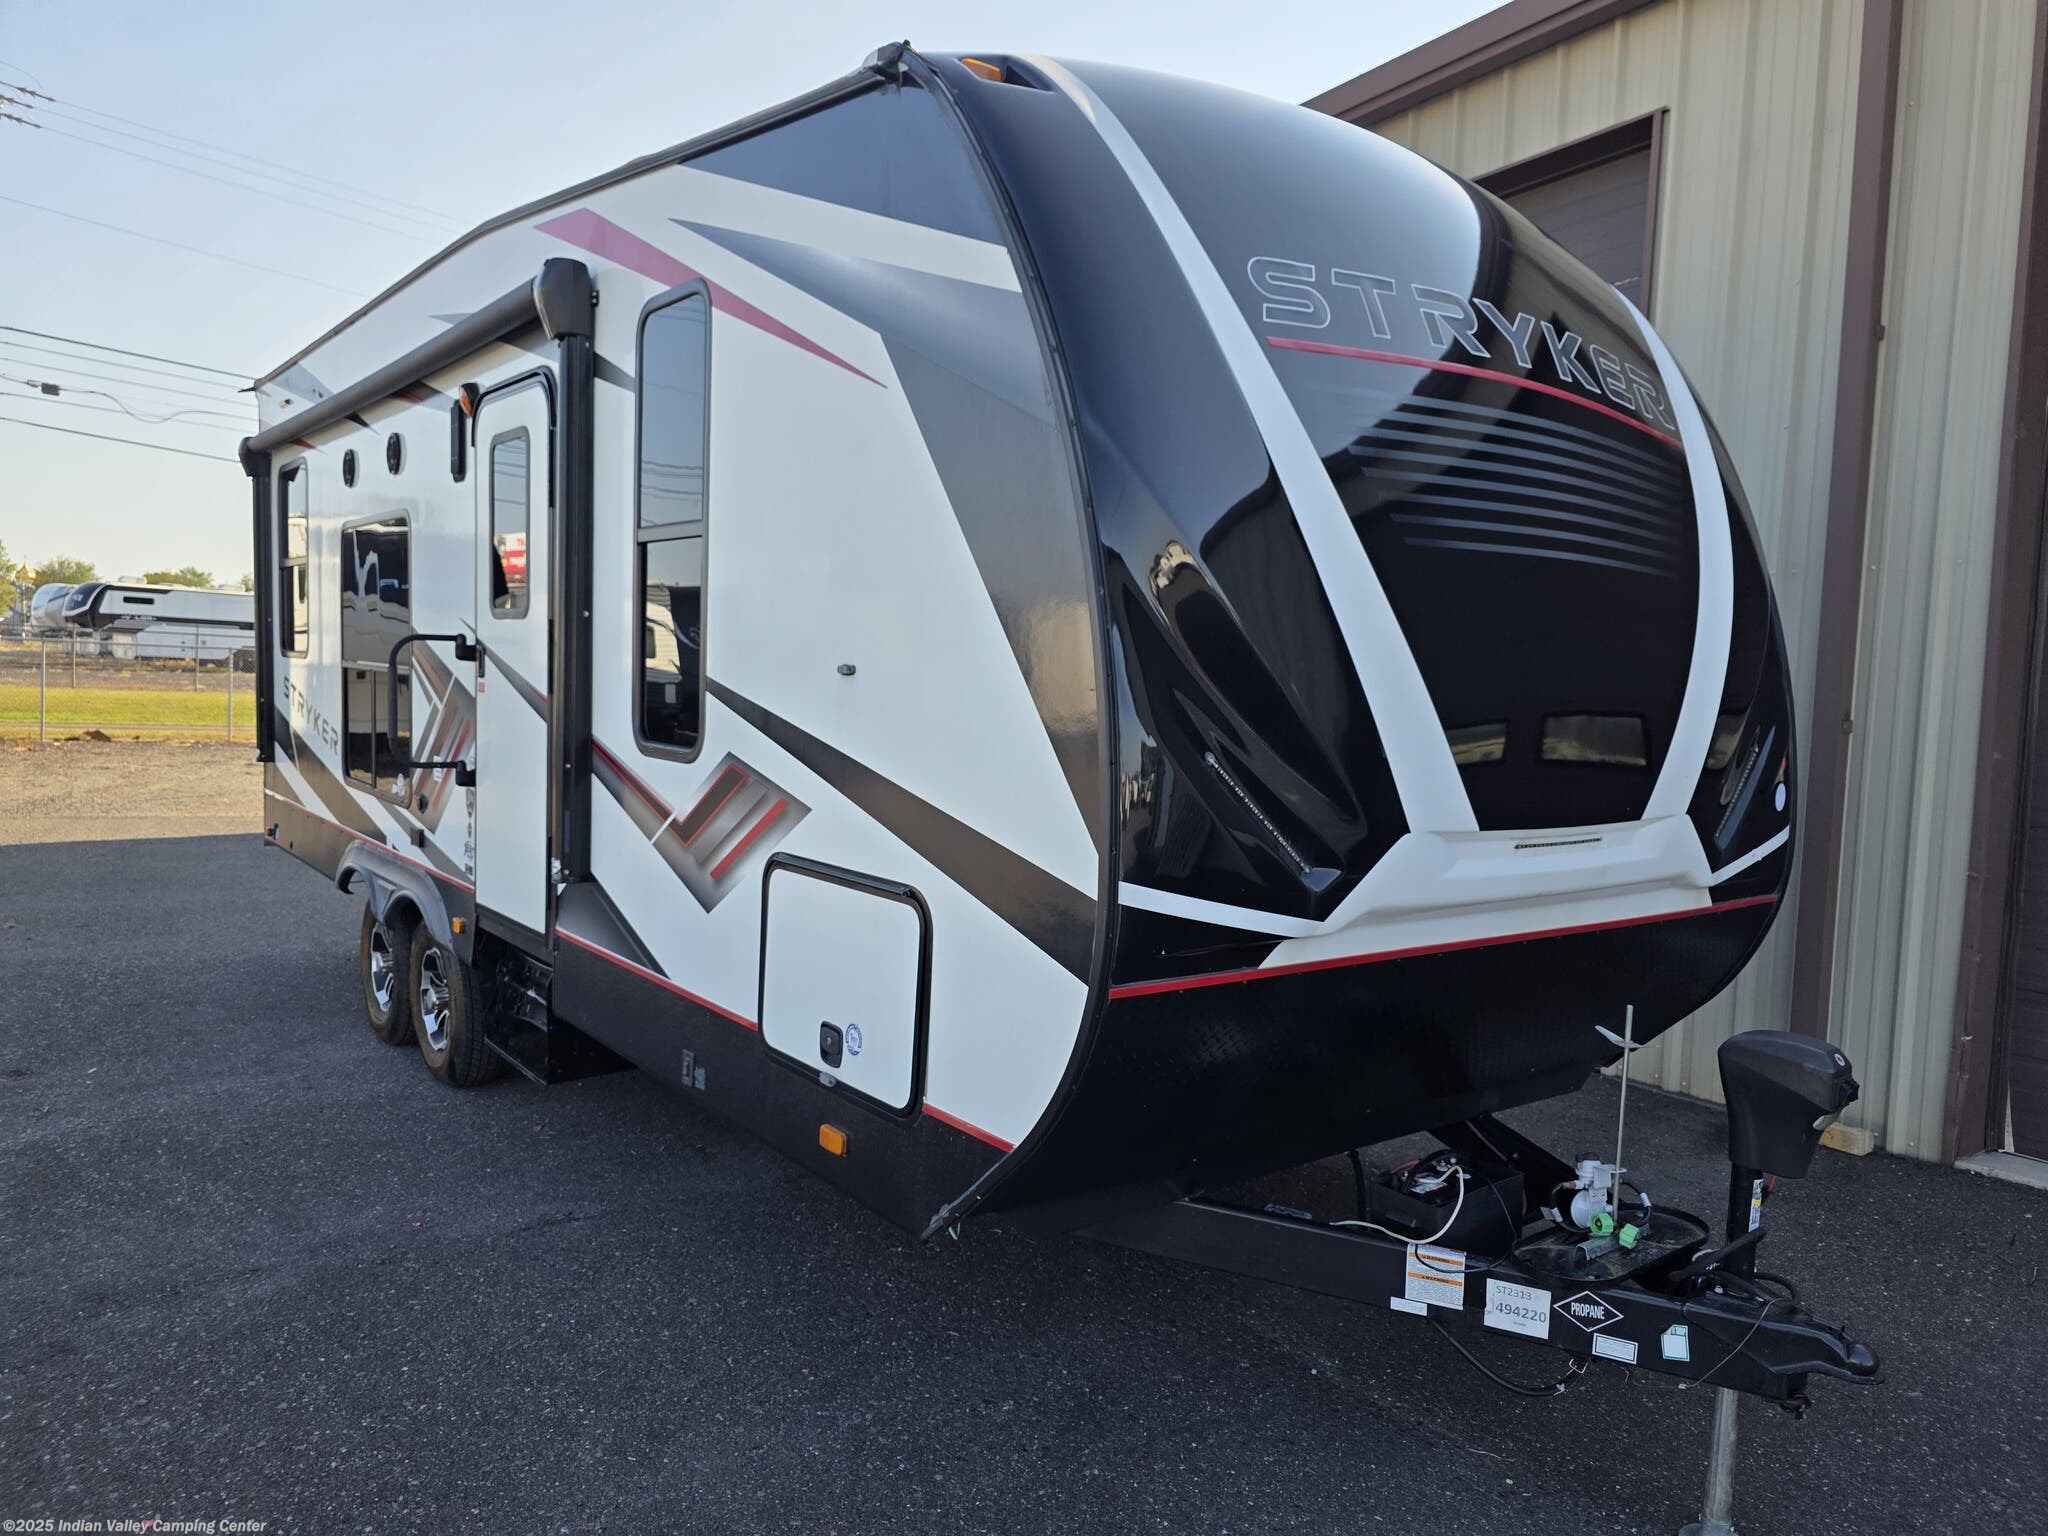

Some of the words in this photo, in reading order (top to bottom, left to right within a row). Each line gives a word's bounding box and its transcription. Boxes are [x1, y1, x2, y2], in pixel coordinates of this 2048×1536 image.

[1247, 256, 1675, 430] STRYKER
[283, 676, 338, 756] STRYKER
[1496, 1285, 1532, 1300] ST2313
[1495, 1302, 1547, 1323] 494220
[1570, 1302, 1605, 1320] PROPANE
